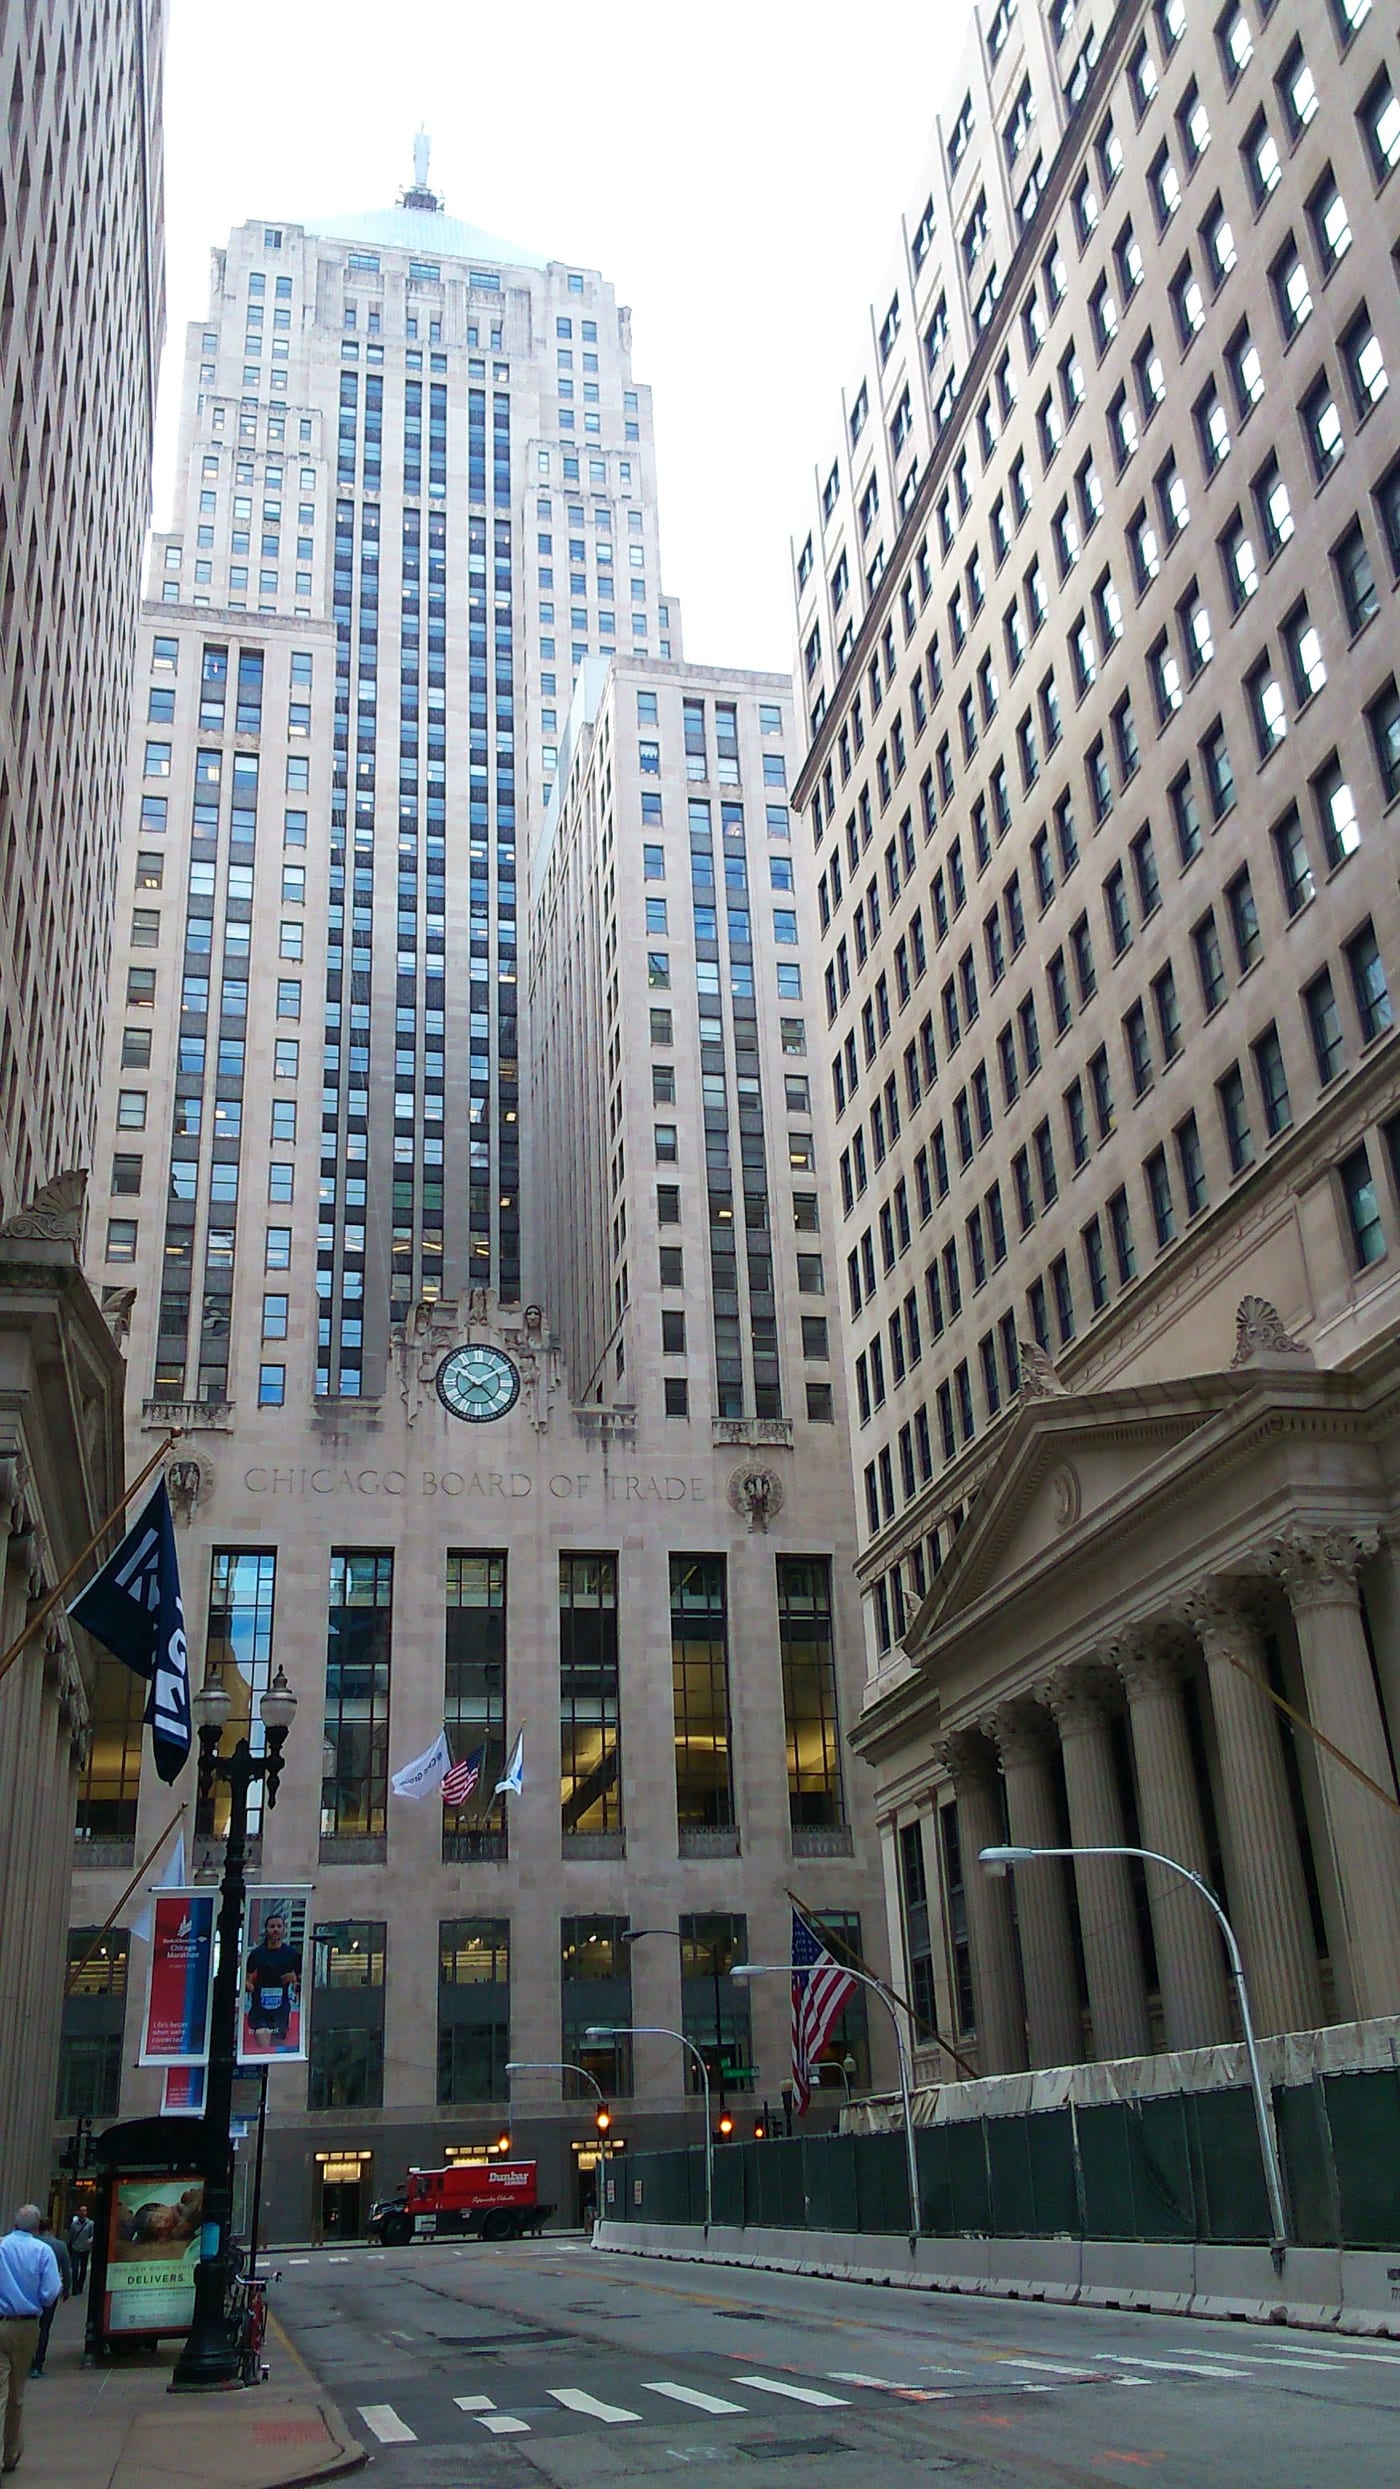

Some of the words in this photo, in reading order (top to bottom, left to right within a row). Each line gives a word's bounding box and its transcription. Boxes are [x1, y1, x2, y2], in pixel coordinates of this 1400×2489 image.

[244, 1467, 407, 1495] CHICAGO
[422, 1471, 532, 1498] BOARD
[549, 1474, 590, 1498] OF
[607, 1475, 705, 1501] TRADE
[170, 1944, 197, 1952] Chicago
[167, 1951, 199, 1959] Marathon
[488, 2170, 529, 2182] Dunbar
[127, 2273, 186, 2285] DELIVERS.
